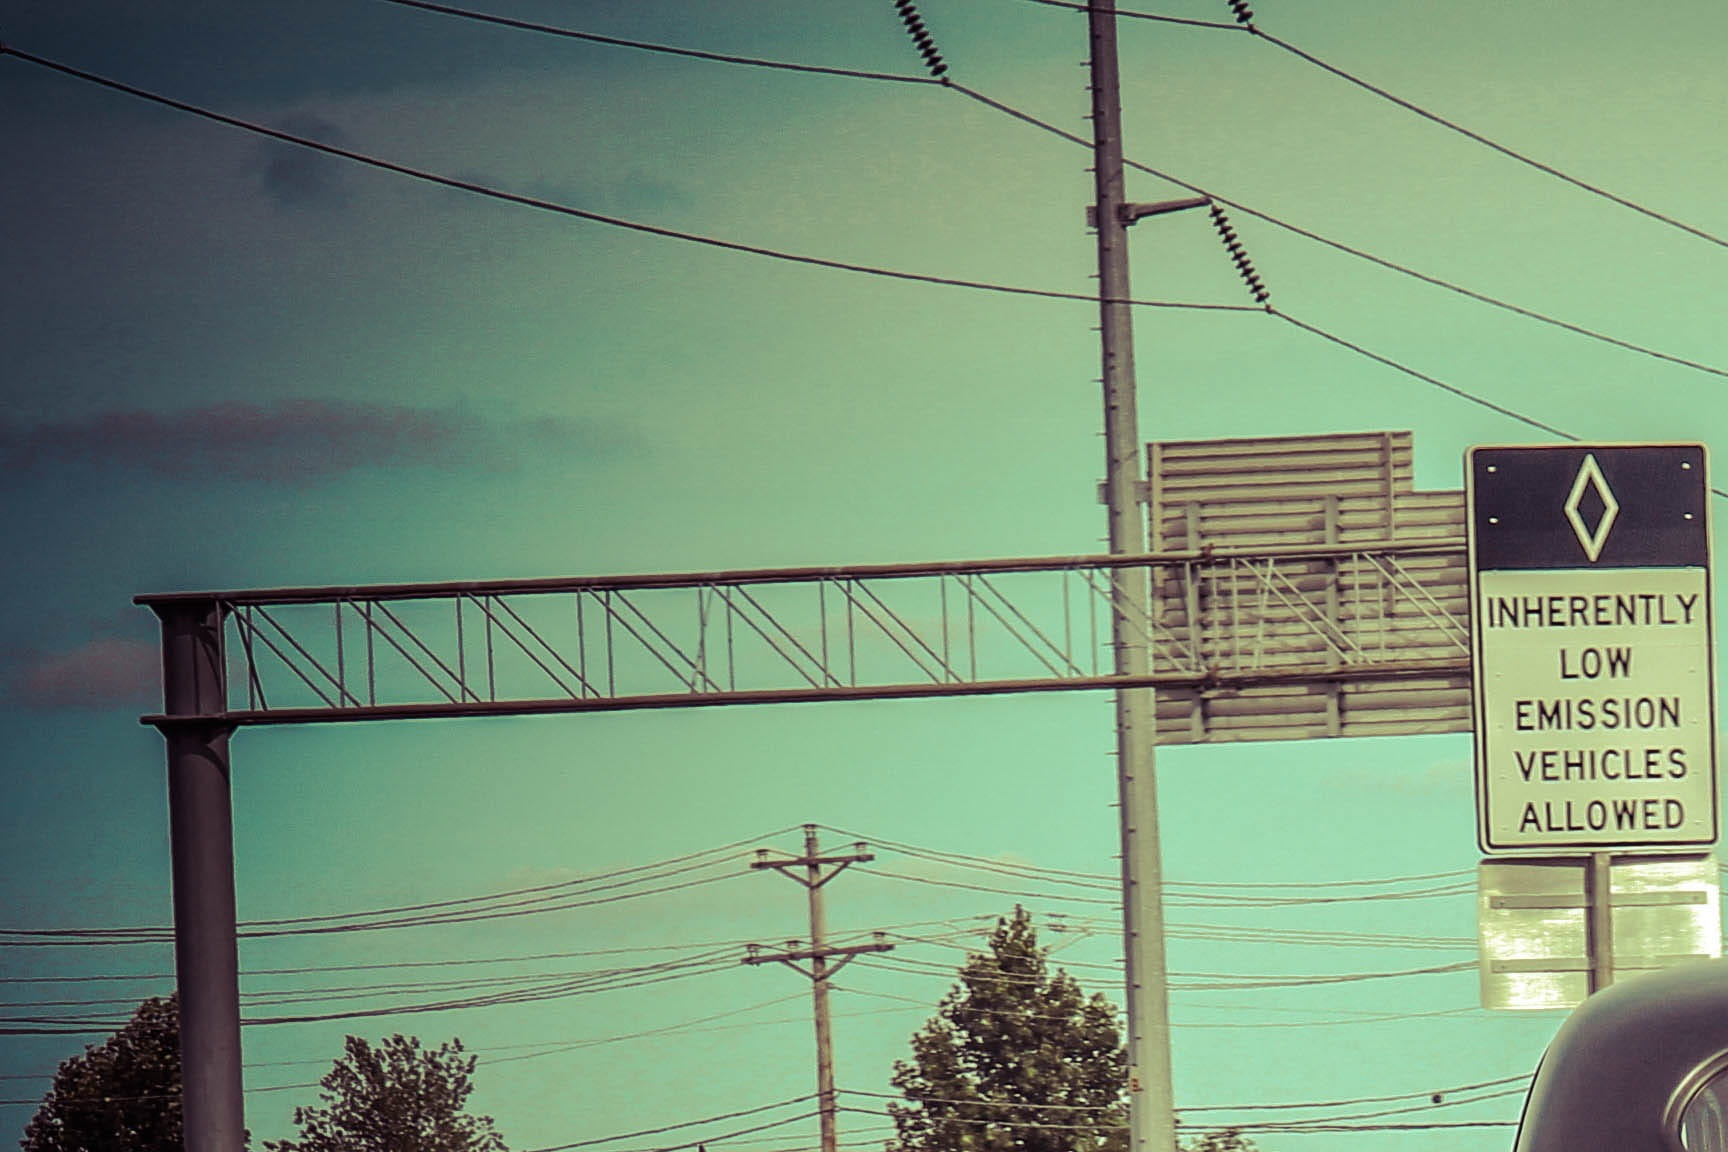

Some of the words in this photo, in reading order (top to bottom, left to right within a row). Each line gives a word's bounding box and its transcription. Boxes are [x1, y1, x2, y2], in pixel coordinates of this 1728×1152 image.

[1488, 594, 1698, 628] INHERENTLY
[1560, 648, 1632, 679] LOW
[1515, 697, 1680, 731] EMISSION
[1514, 748, 1687, 782] VEHICLES
[1519, 799, 1684, 832] ALLOWED
